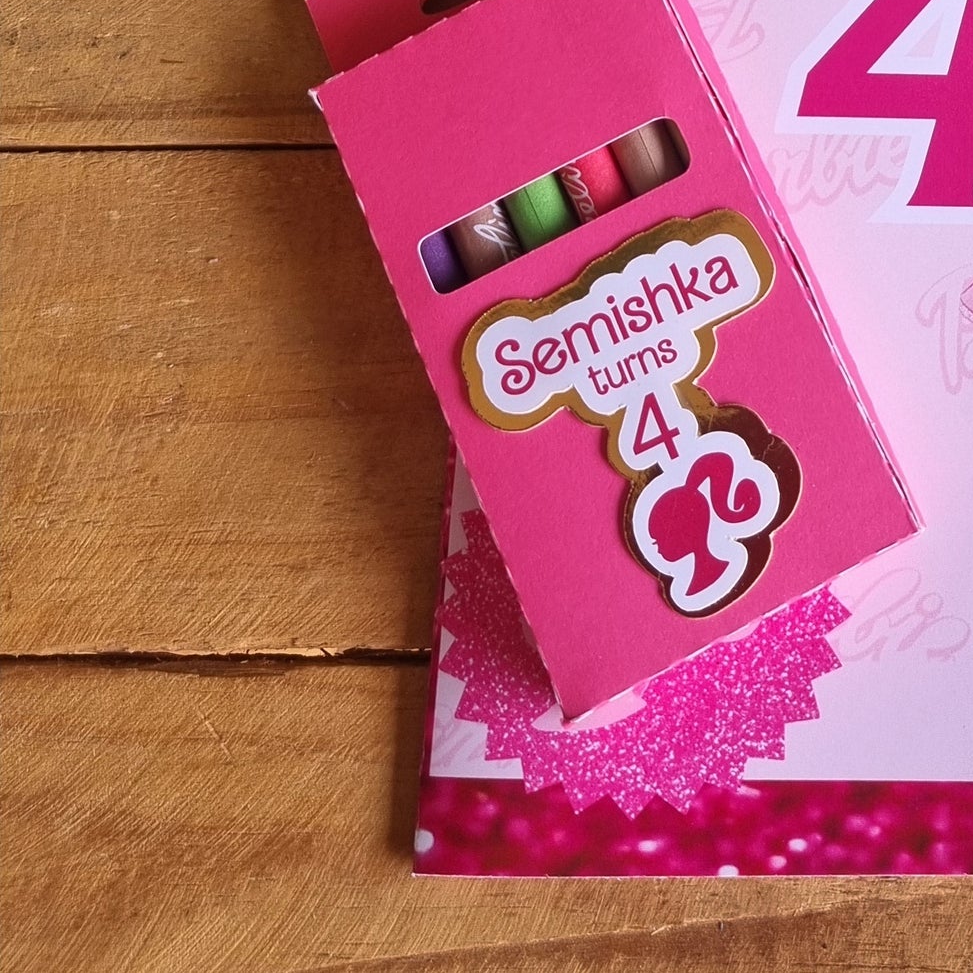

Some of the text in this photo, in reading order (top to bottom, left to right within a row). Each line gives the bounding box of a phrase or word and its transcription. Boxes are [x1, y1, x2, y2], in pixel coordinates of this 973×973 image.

[494, 255, 739, 395] Semishka
[588, 338, 678, 395] turns
[632, 392, 681, 460] 4
